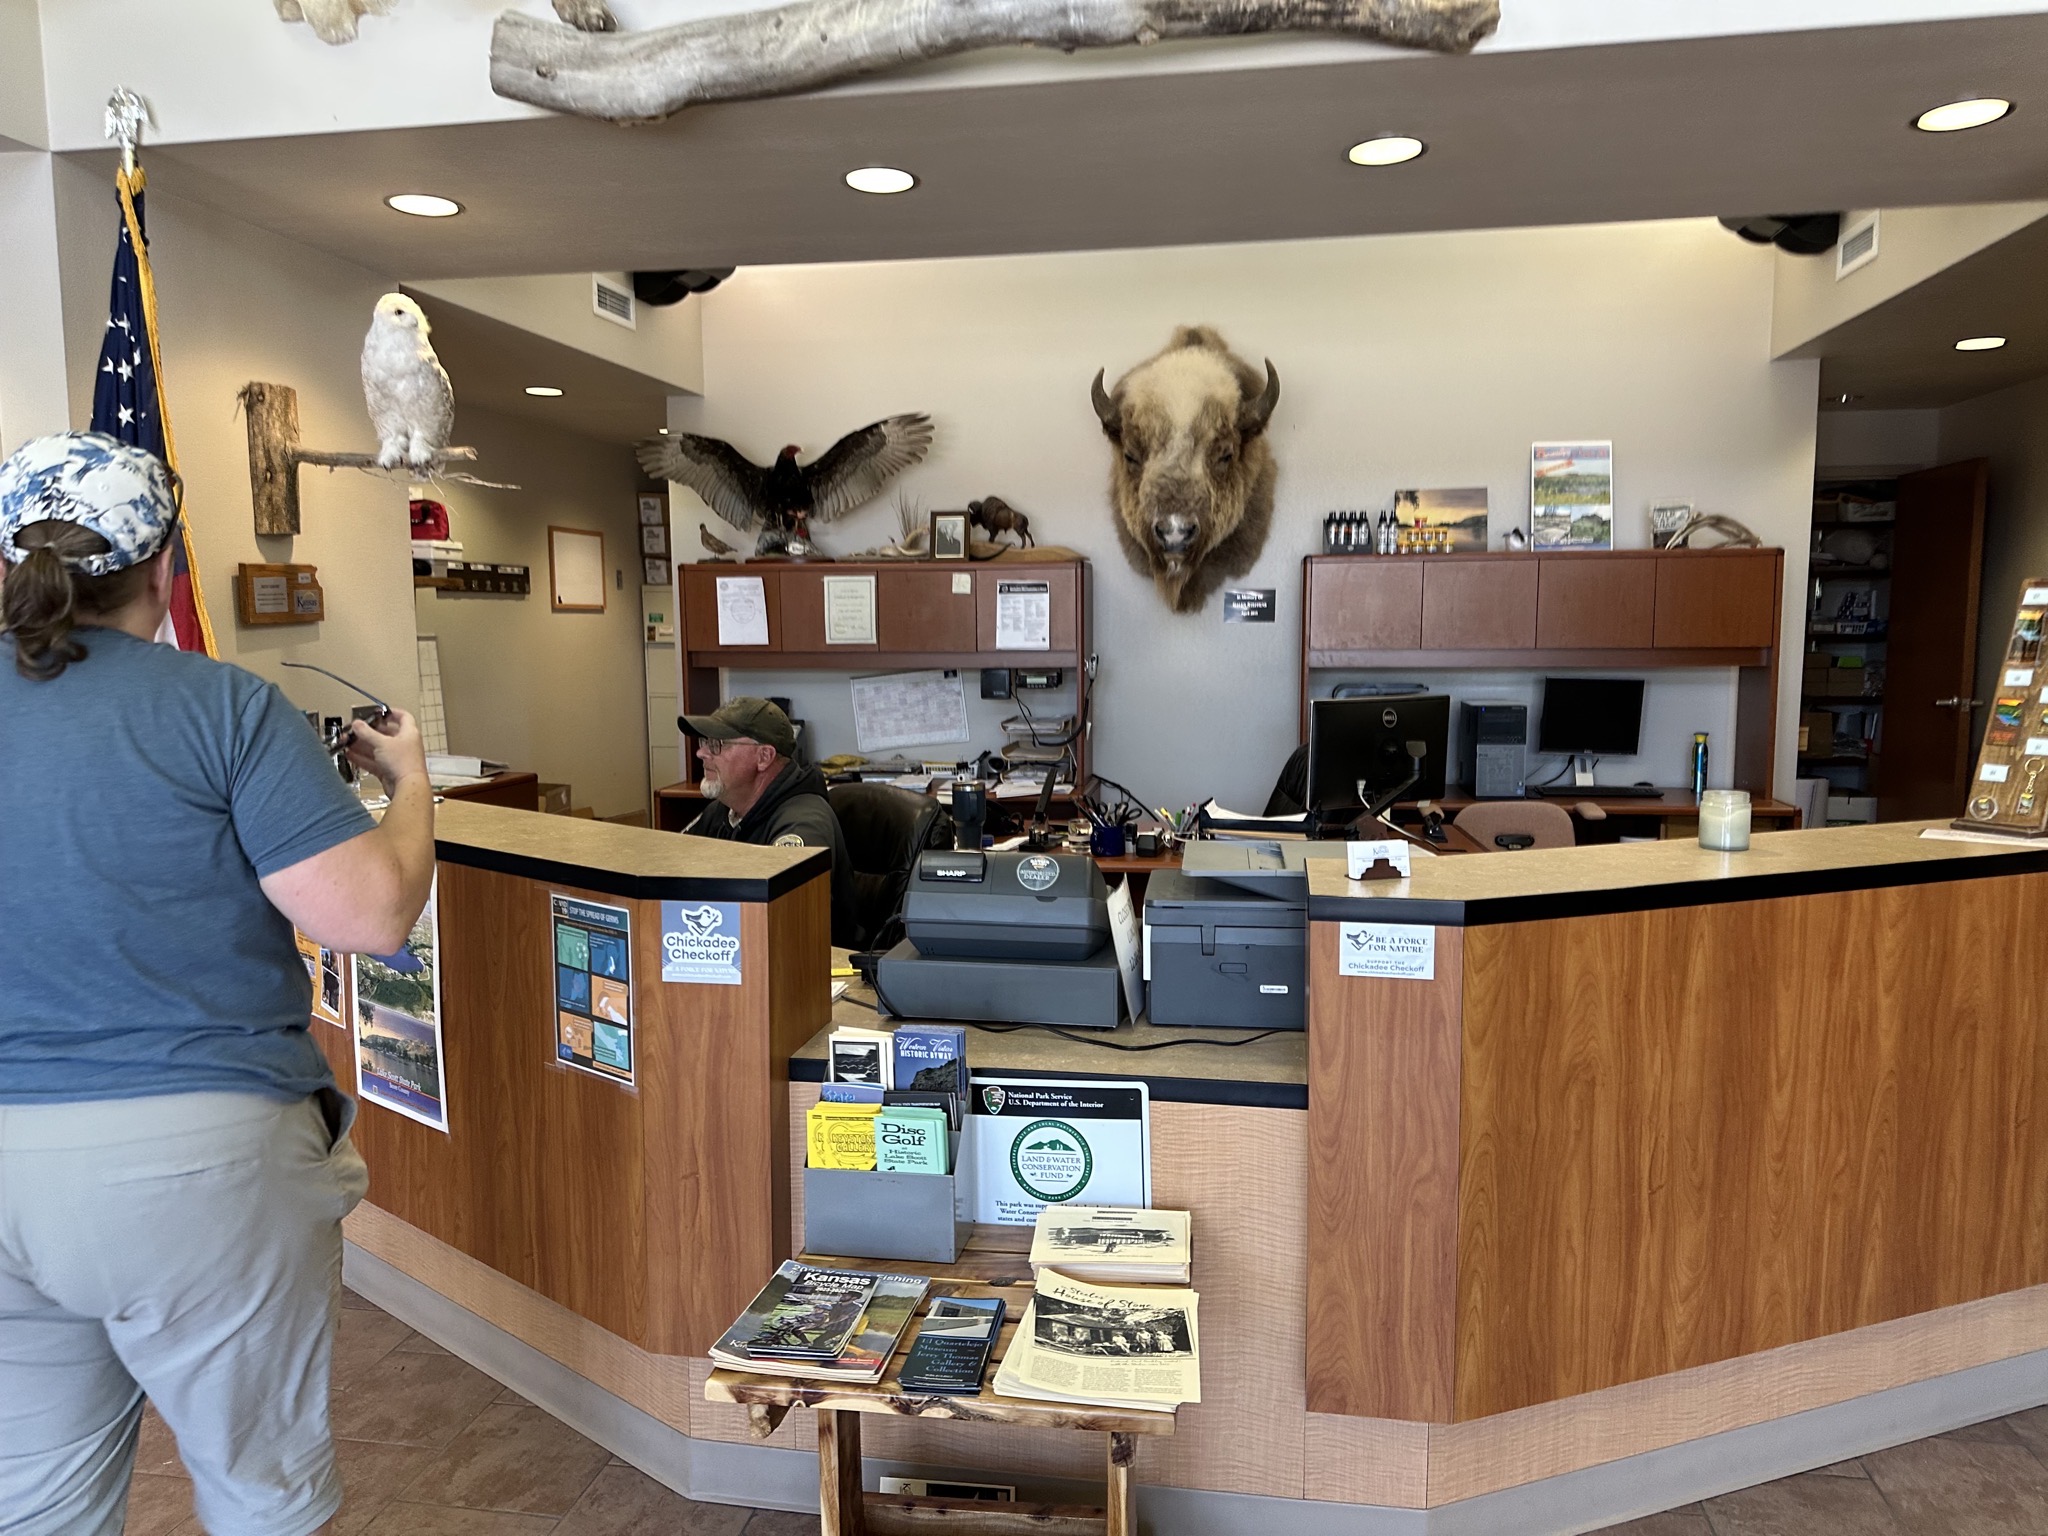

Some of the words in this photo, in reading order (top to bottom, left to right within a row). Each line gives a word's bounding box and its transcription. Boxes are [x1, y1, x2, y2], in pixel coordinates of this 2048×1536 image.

[570, 906, 578, 914] STOP
[586, 910, 600, 920] SPREAD
[606, 914, 619, 924] GERMS
[666, 936, 736, 948] Chickadee
[672, 948, 731, 961] Checkoff
[896, 1036, 926, 1050] Western
[929, 1038, 953, 1052] Vistas
[900, 1050, 929, 1058] HISTORIC
[930, 1052, 952, 1060] BYWAY
[411, 1080, 421, 1092] Park
[1023, 1100, 1059, 1108] Department
[881, 1123, 926, 1135] Disc
[882, 1134, 926, 1146] Golf
[1021, 1163, 1081, 1172] CONSERVATION
[804, 1272, 870, 1285] Kansas
[1053, 1288, 1094, 1303] House
[1097, 1300, 1115, 1310] of
[1119, 1300, 1153, 1309] Stone
[935, 1340, 983, 1348] Quartelejo
